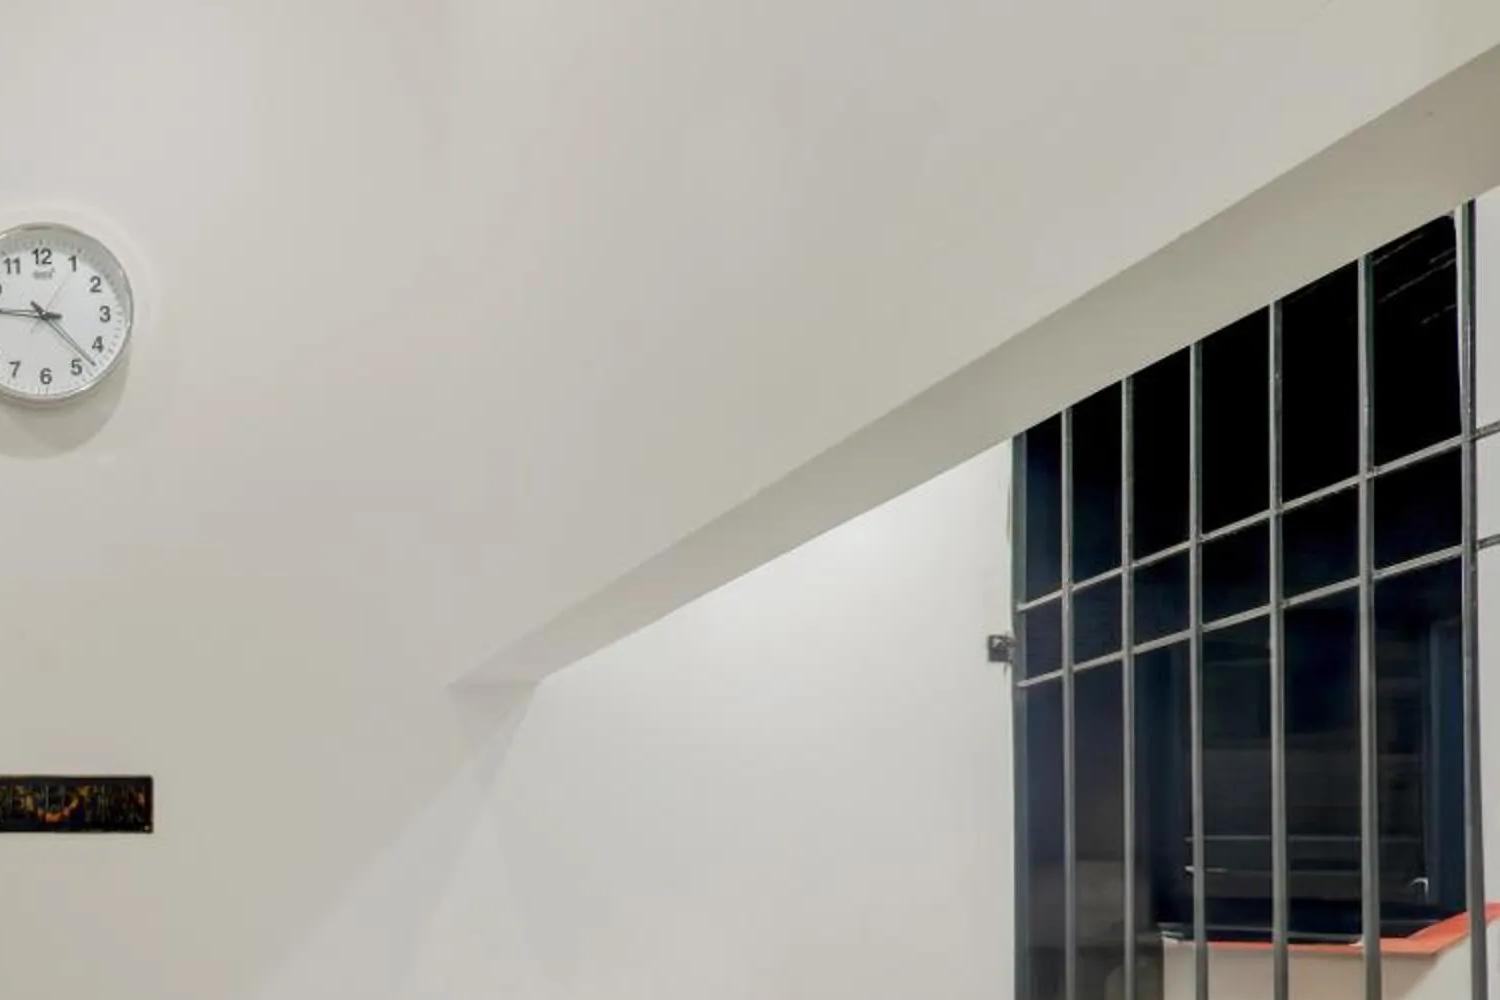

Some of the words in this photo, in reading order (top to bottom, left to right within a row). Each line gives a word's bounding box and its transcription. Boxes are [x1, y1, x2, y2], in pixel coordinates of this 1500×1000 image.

[31, 248, 52, 265] 12
[68, 256, 77, 272] 1
[4, 258, 21, 274] 11
[90, 276, 102, 293] 2
[100, 306, 111, 322] 3
[92, 336, 104, 352] 4
[9, 361, 21, 378] 7
[70, 359, 83, 376] 5
[40, 368, 52, 385] 6
